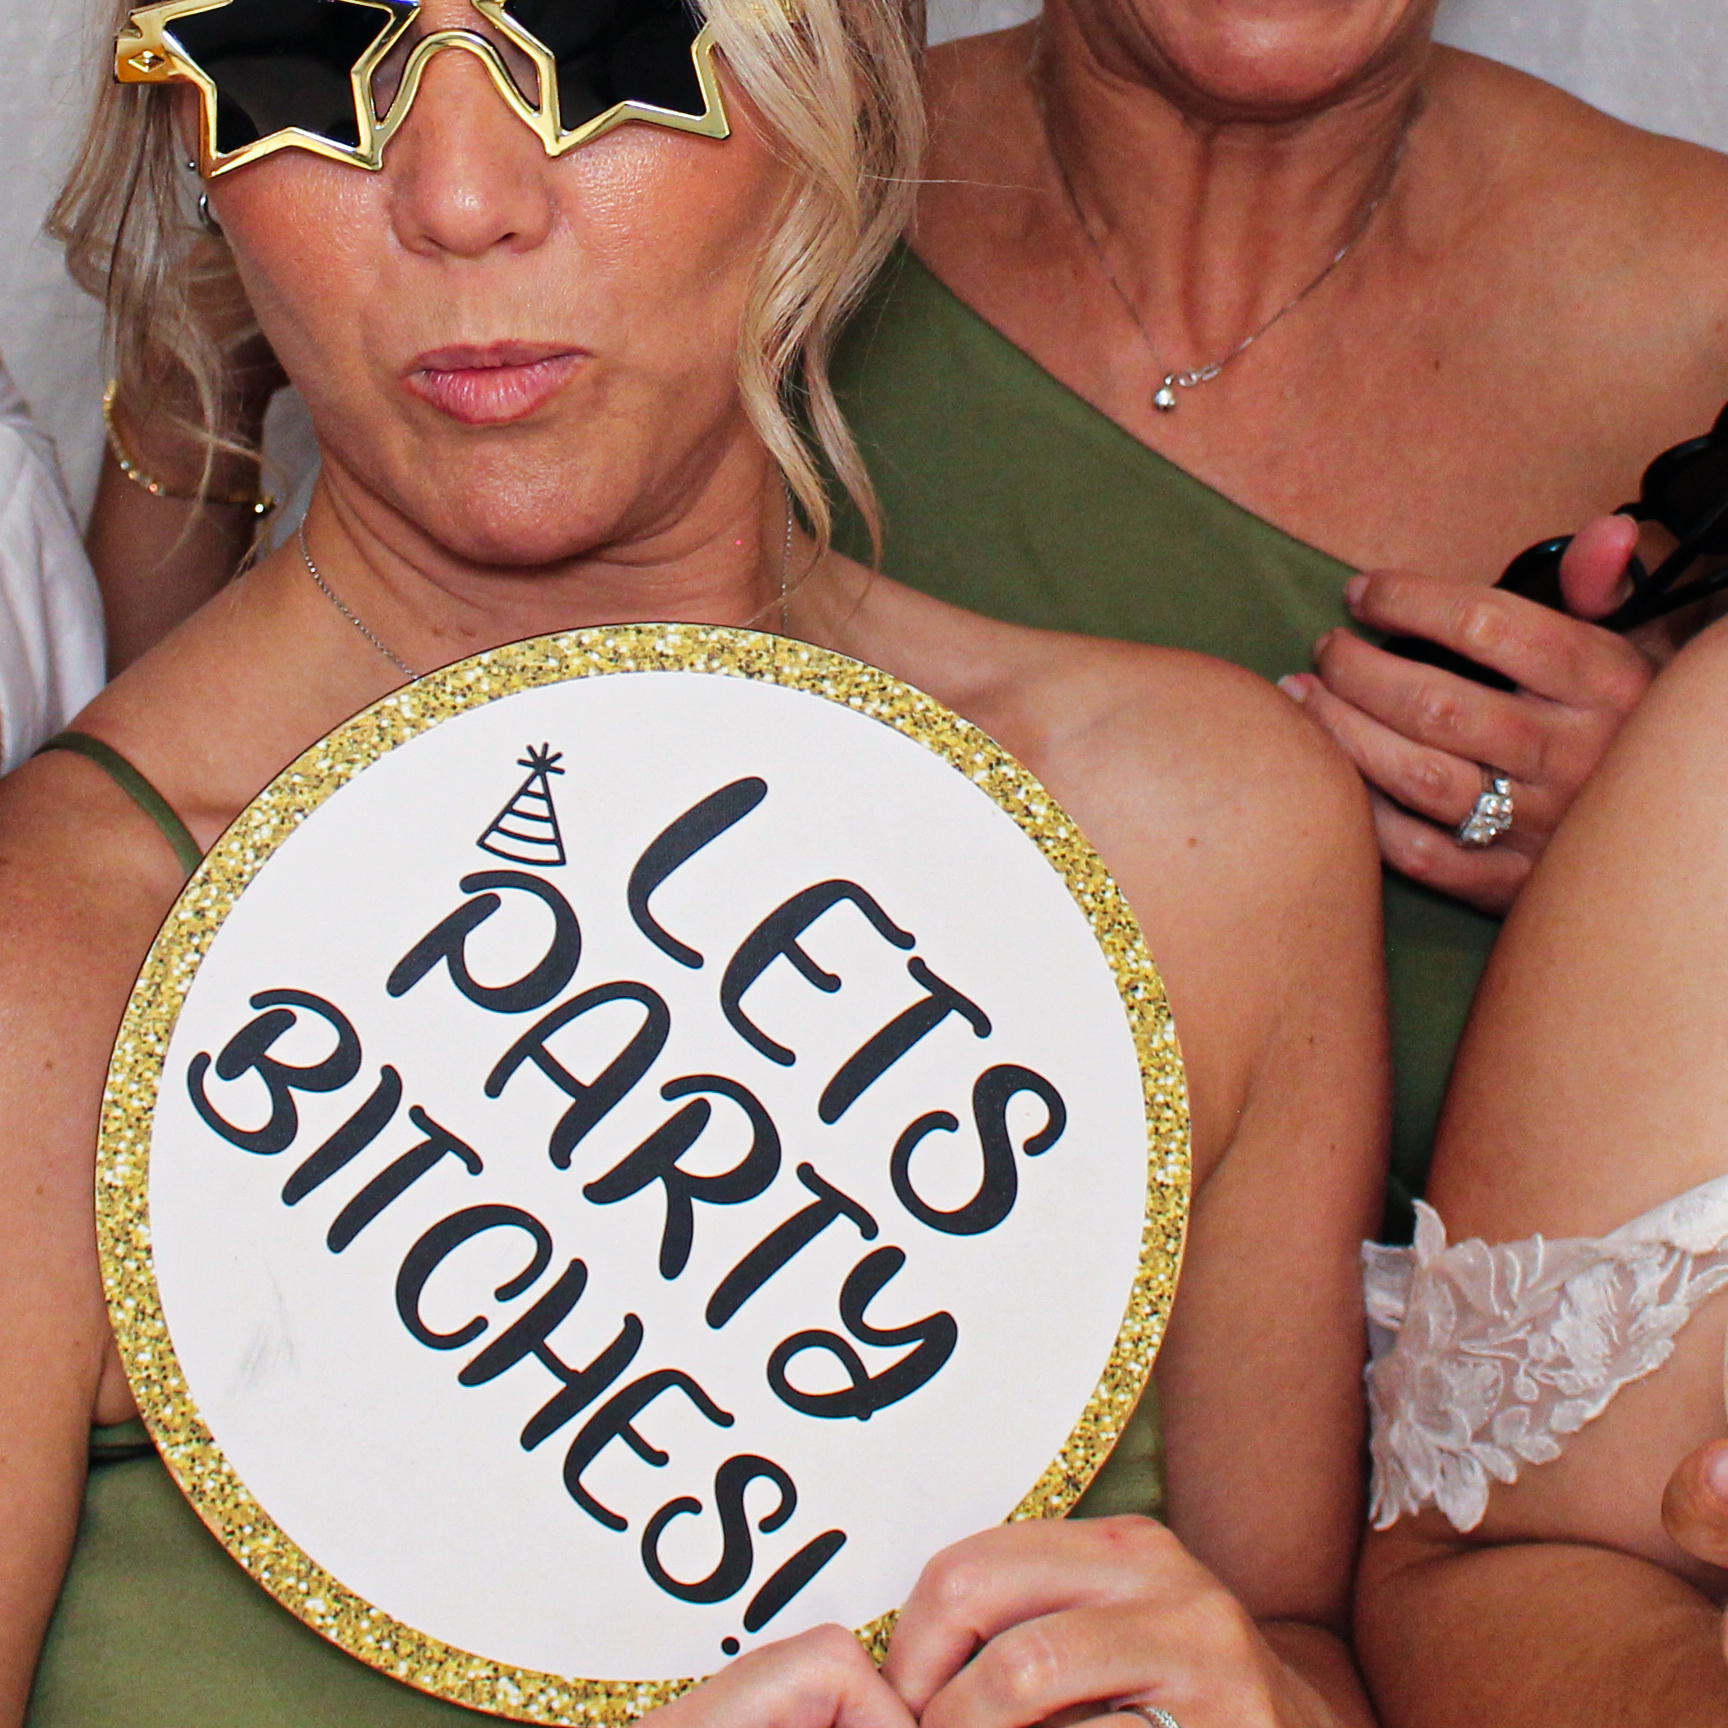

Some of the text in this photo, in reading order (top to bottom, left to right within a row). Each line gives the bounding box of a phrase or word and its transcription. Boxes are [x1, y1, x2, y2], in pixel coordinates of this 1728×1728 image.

[385, 869, 959, 1422] PARTY
[627, 775, 1068, 1237] LETS
[186, 988, 848, 1656] BITCHES!
